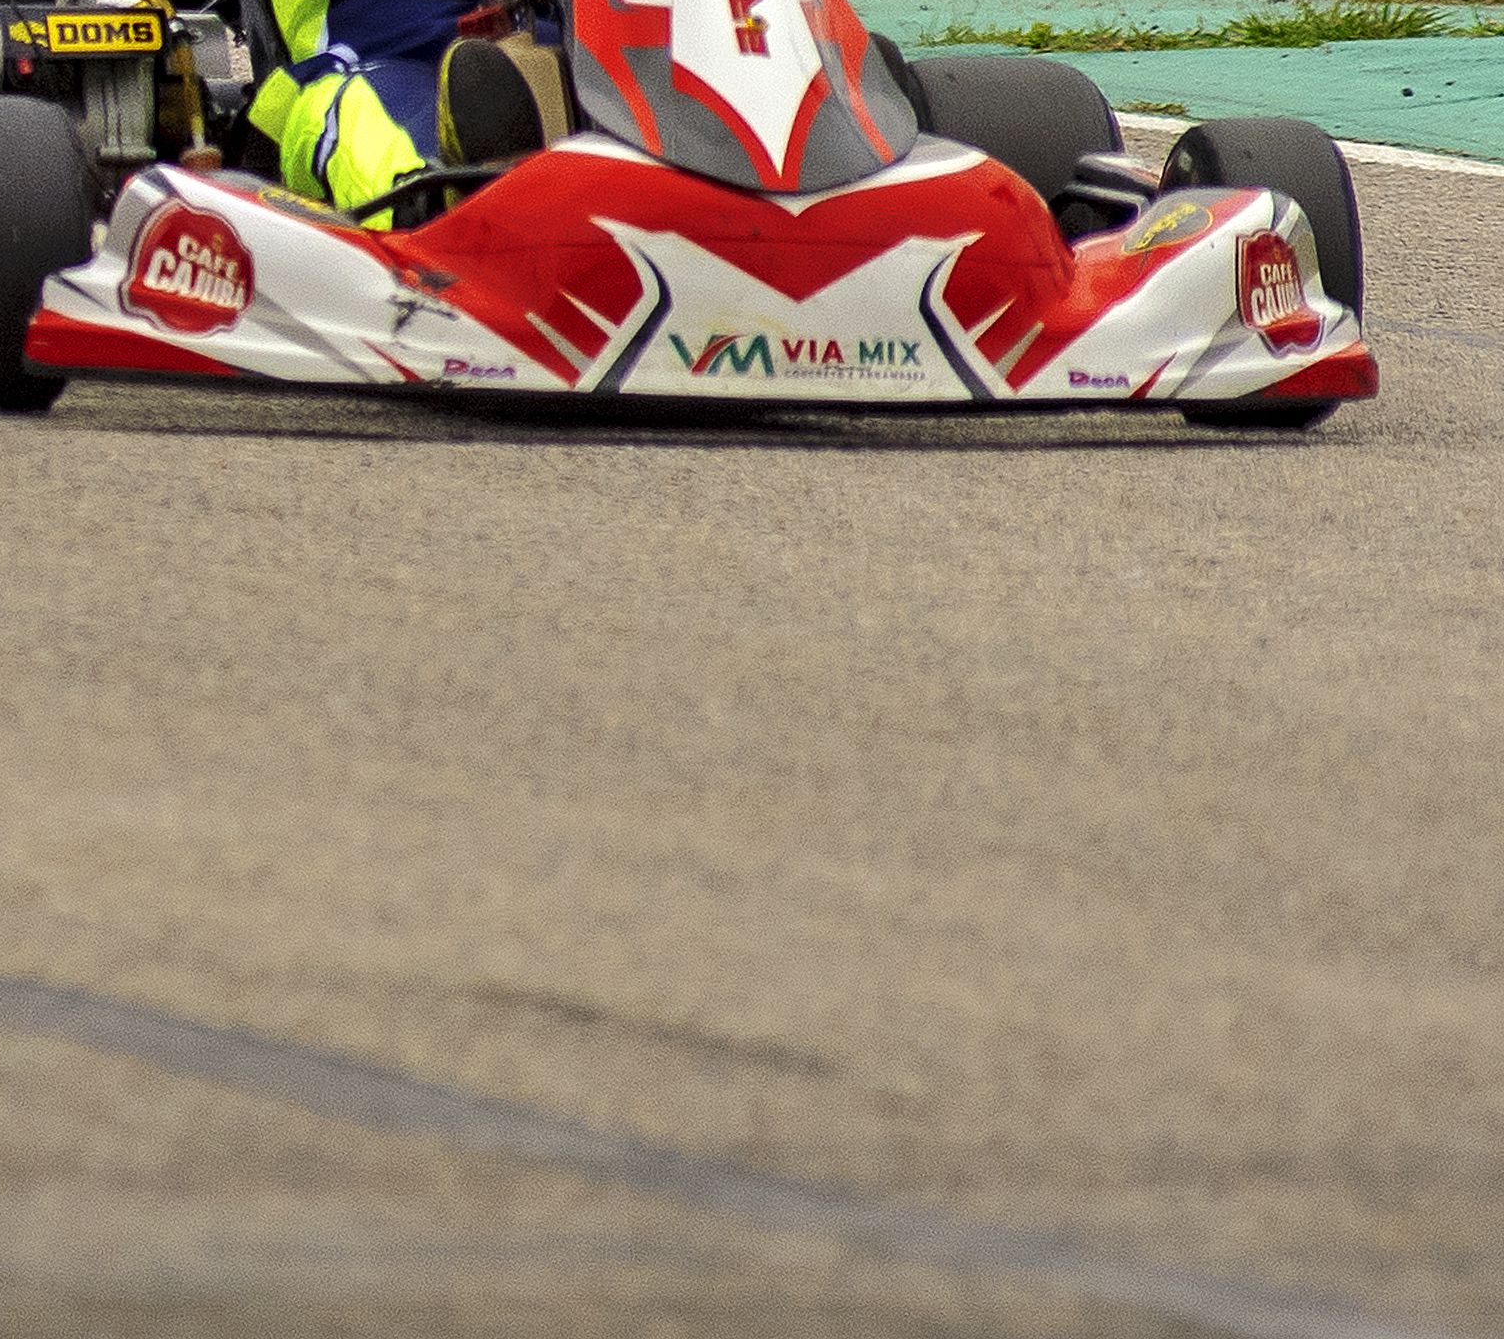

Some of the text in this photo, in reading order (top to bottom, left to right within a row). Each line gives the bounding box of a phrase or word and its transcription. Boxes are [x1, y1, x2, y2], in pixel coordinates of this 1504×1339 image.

[55, 21, 154, 44] DOMS
[781, 339, 922, 366] VIA MIX
